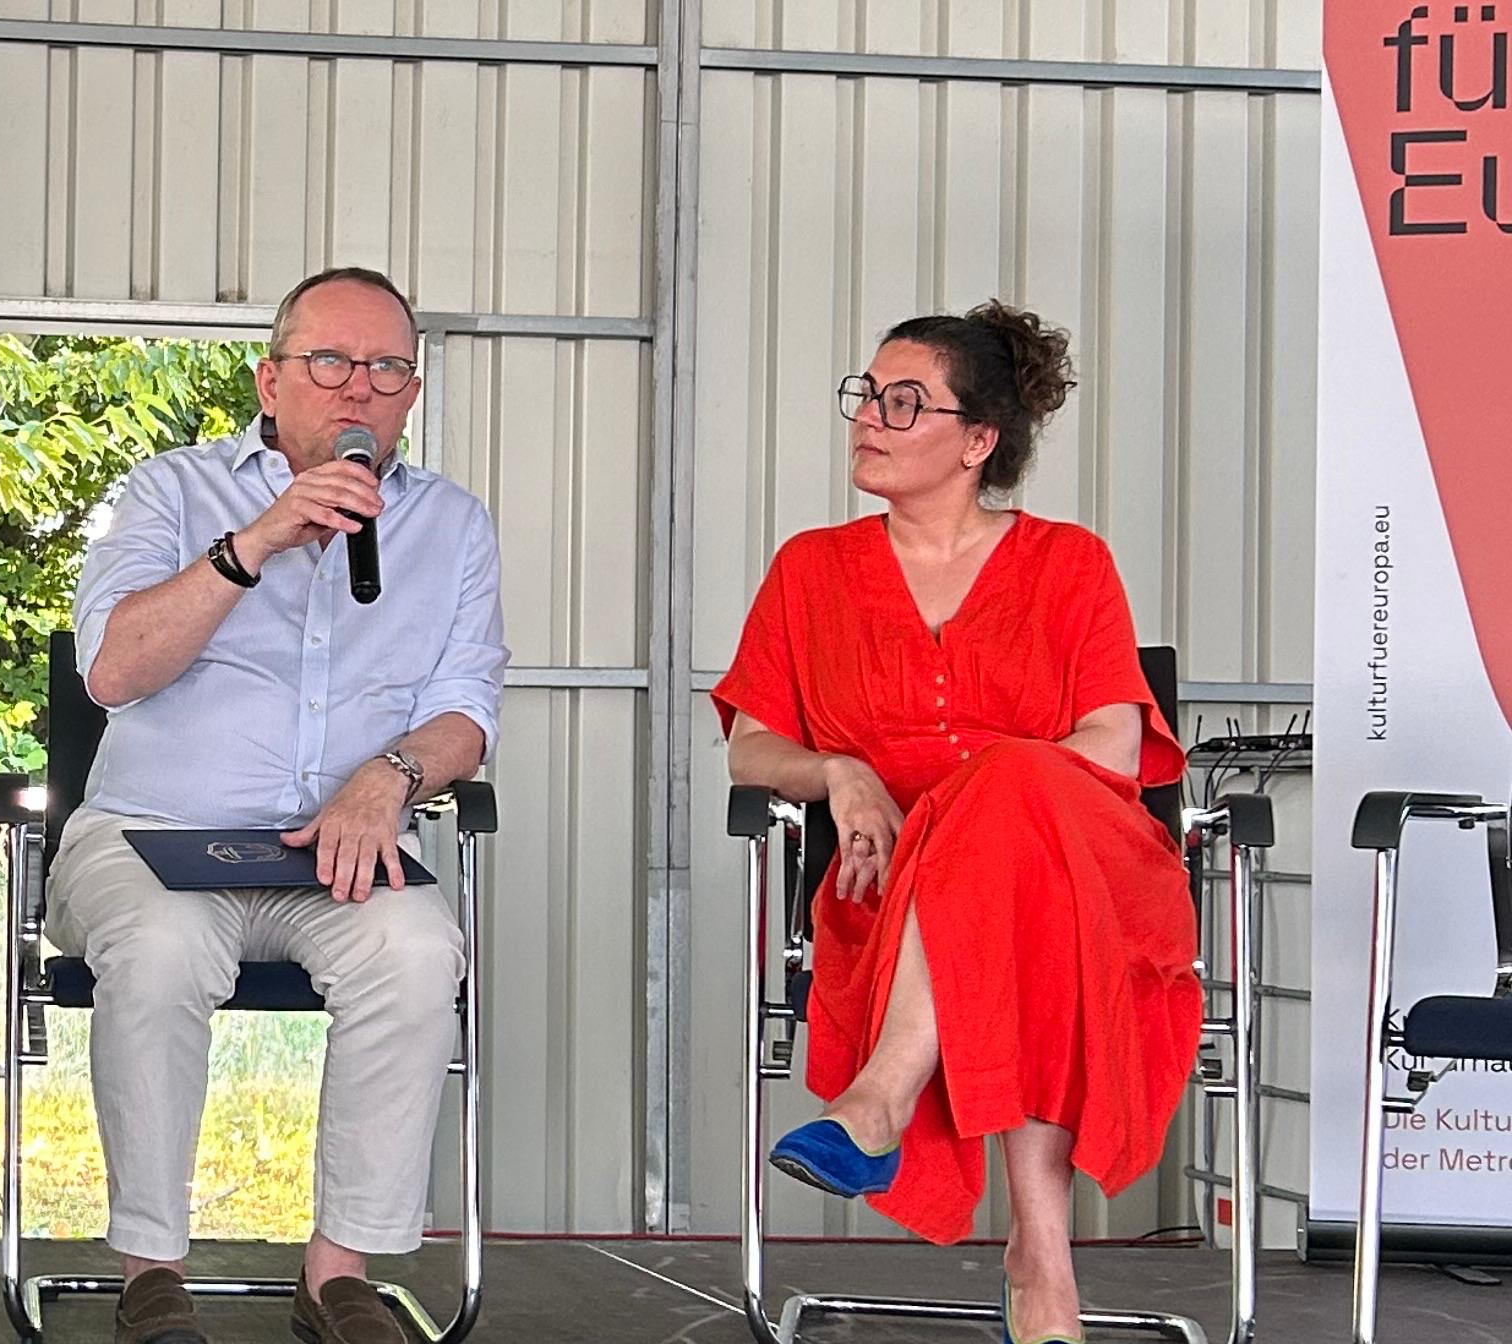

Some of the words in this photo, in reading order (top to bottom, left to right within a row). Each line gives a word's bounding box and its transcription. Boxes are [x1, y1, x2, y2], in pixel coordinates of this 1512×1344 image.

[1367, 505, 1394, 741] kulturfuereuropa.eu
[1383, 1147, 1431, 1170] der
[1439, 1148, 1512, 1172] Metr
